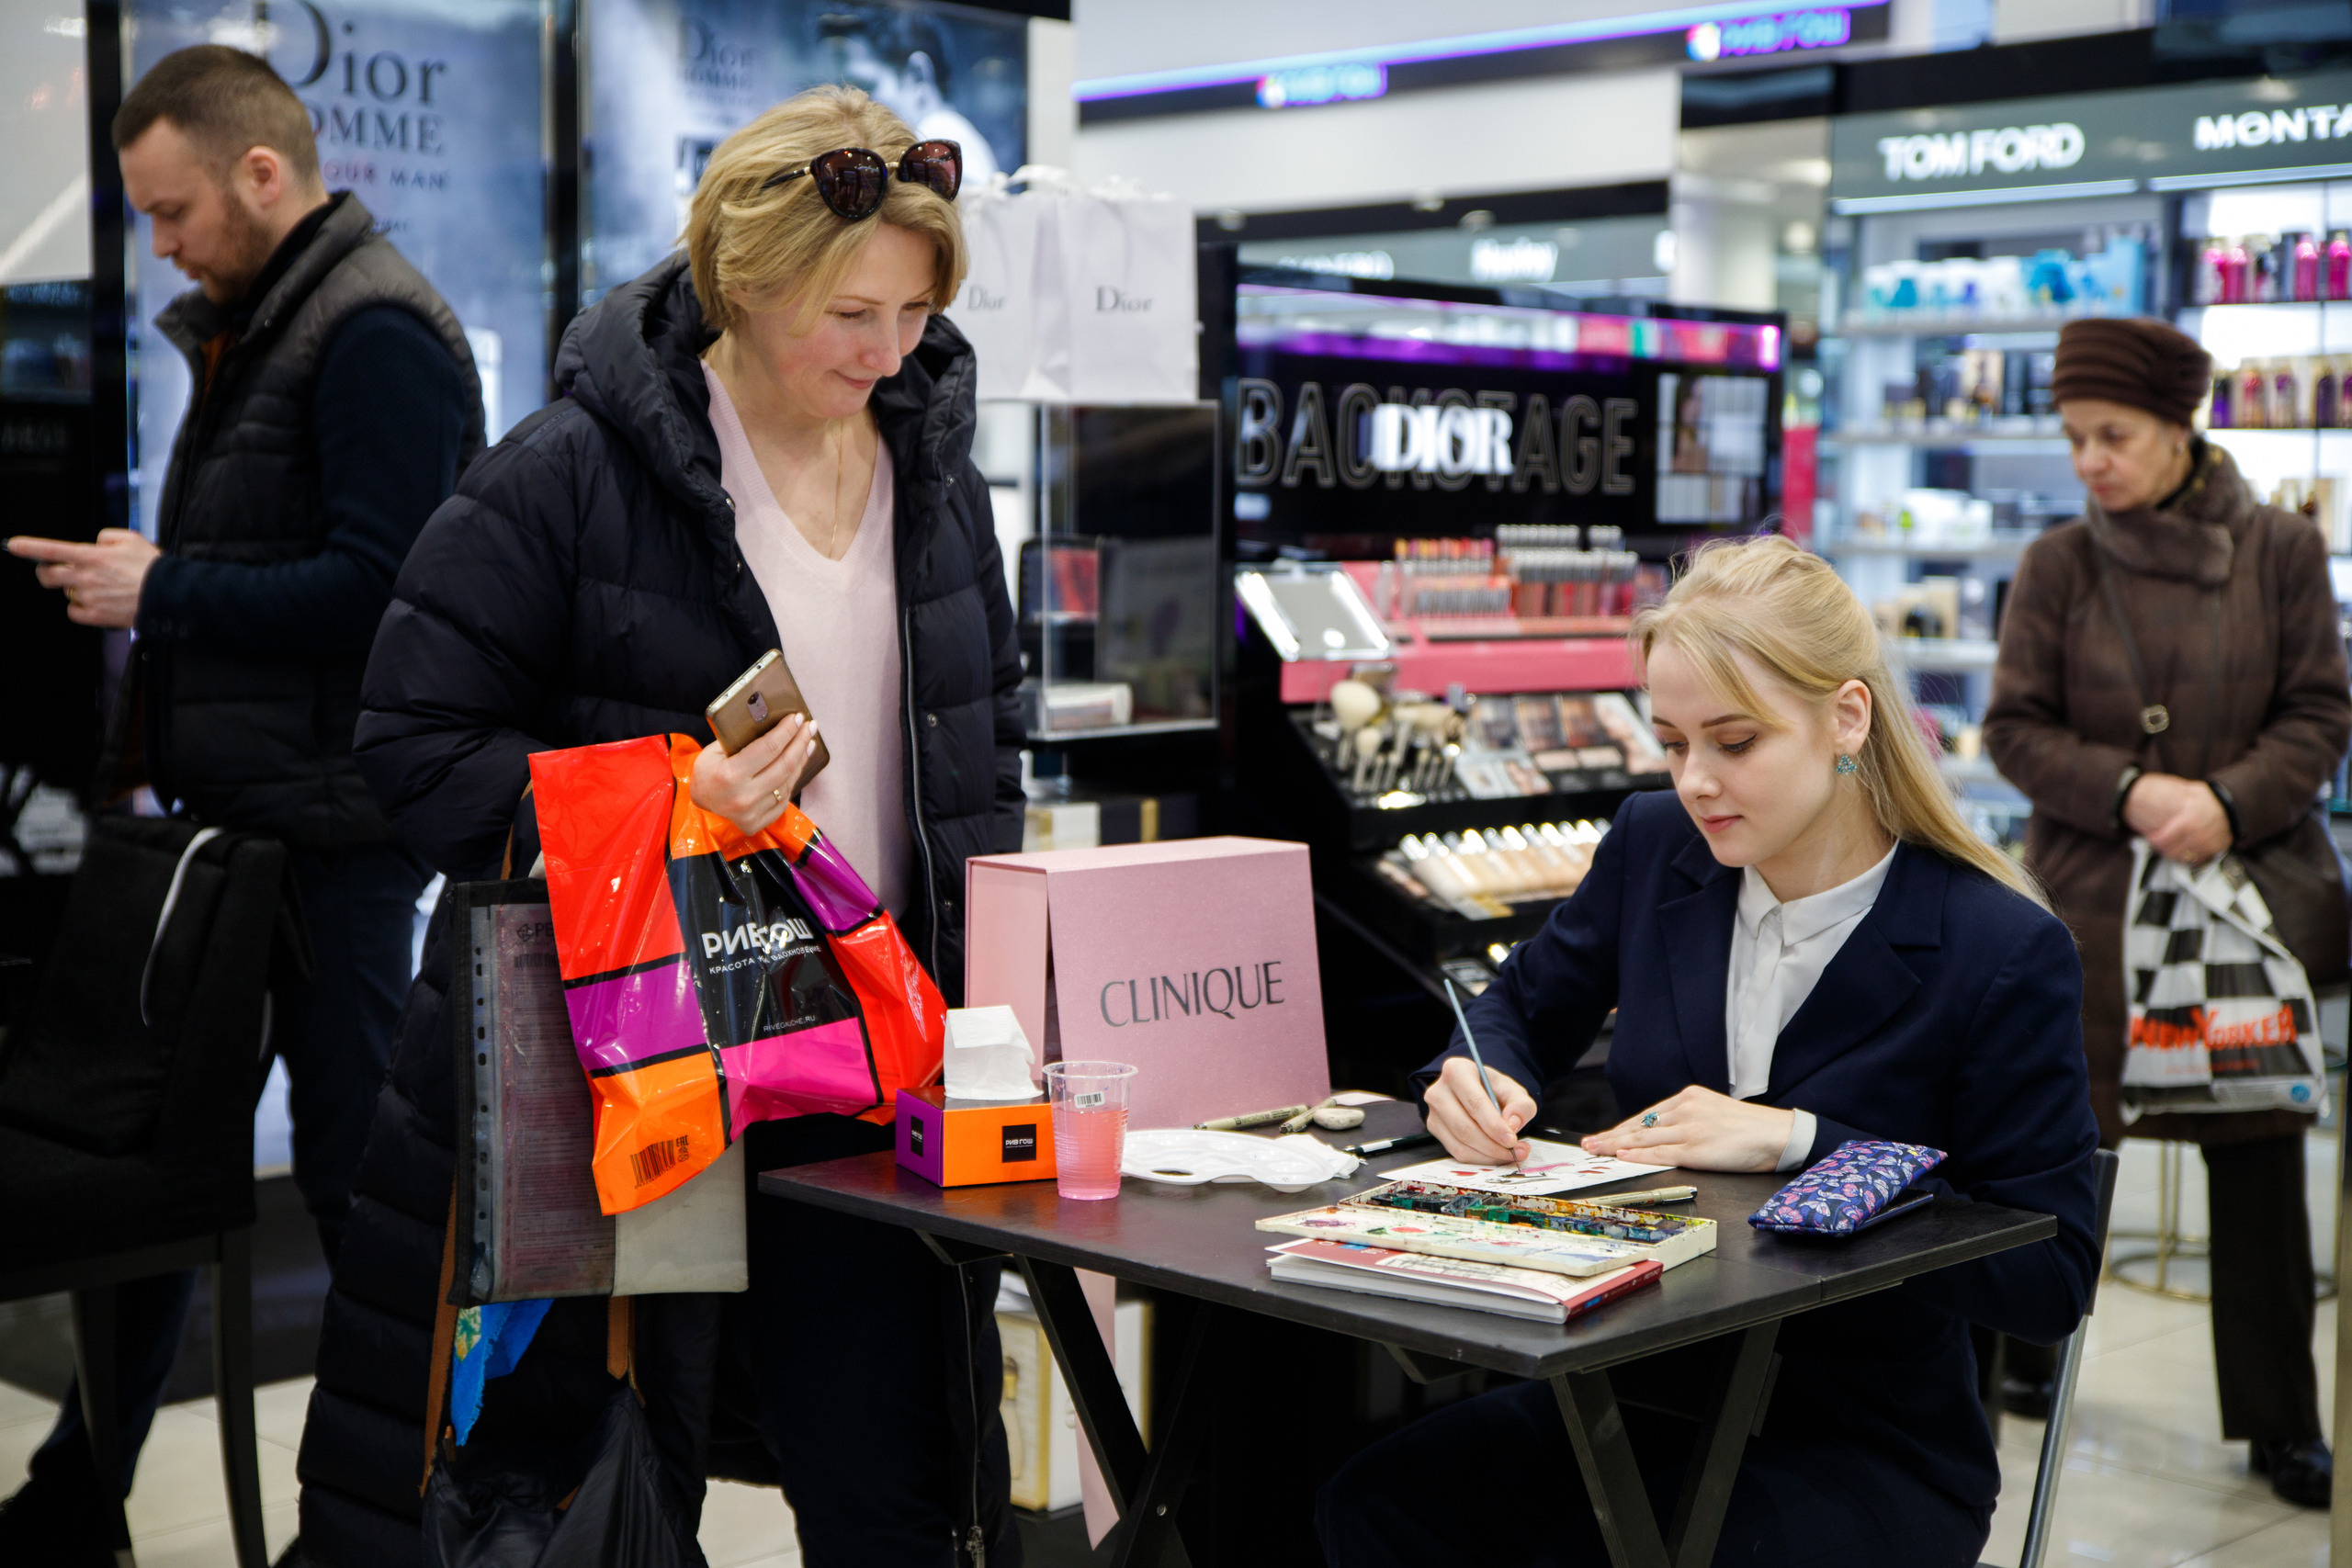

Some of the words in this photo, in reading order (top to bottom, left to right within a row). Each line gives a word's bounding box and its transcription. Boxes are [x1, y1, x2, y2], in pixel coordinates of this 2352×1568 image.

[254, 0, 447, 105] Dior
[305, 103, 446, 155] OMME
[1877, 133, 1968, 181] TOM
[1969, 122, 2085, 175] FORD
[323, 159, 376, 184] OUR
[390, 167, 448, 191] MAN
[967, 284, 1006, 311] Dior
[1096, 286, 1153, 312] Dior
[1372, 403, 1515, 476] DIOR
[708, 957, 755, 975] КРАСОТА
[1100, 961, 1285, 1027] CLINIQUE
[763, 1015, 816, 1032] RIVEGAUCHE.RU
